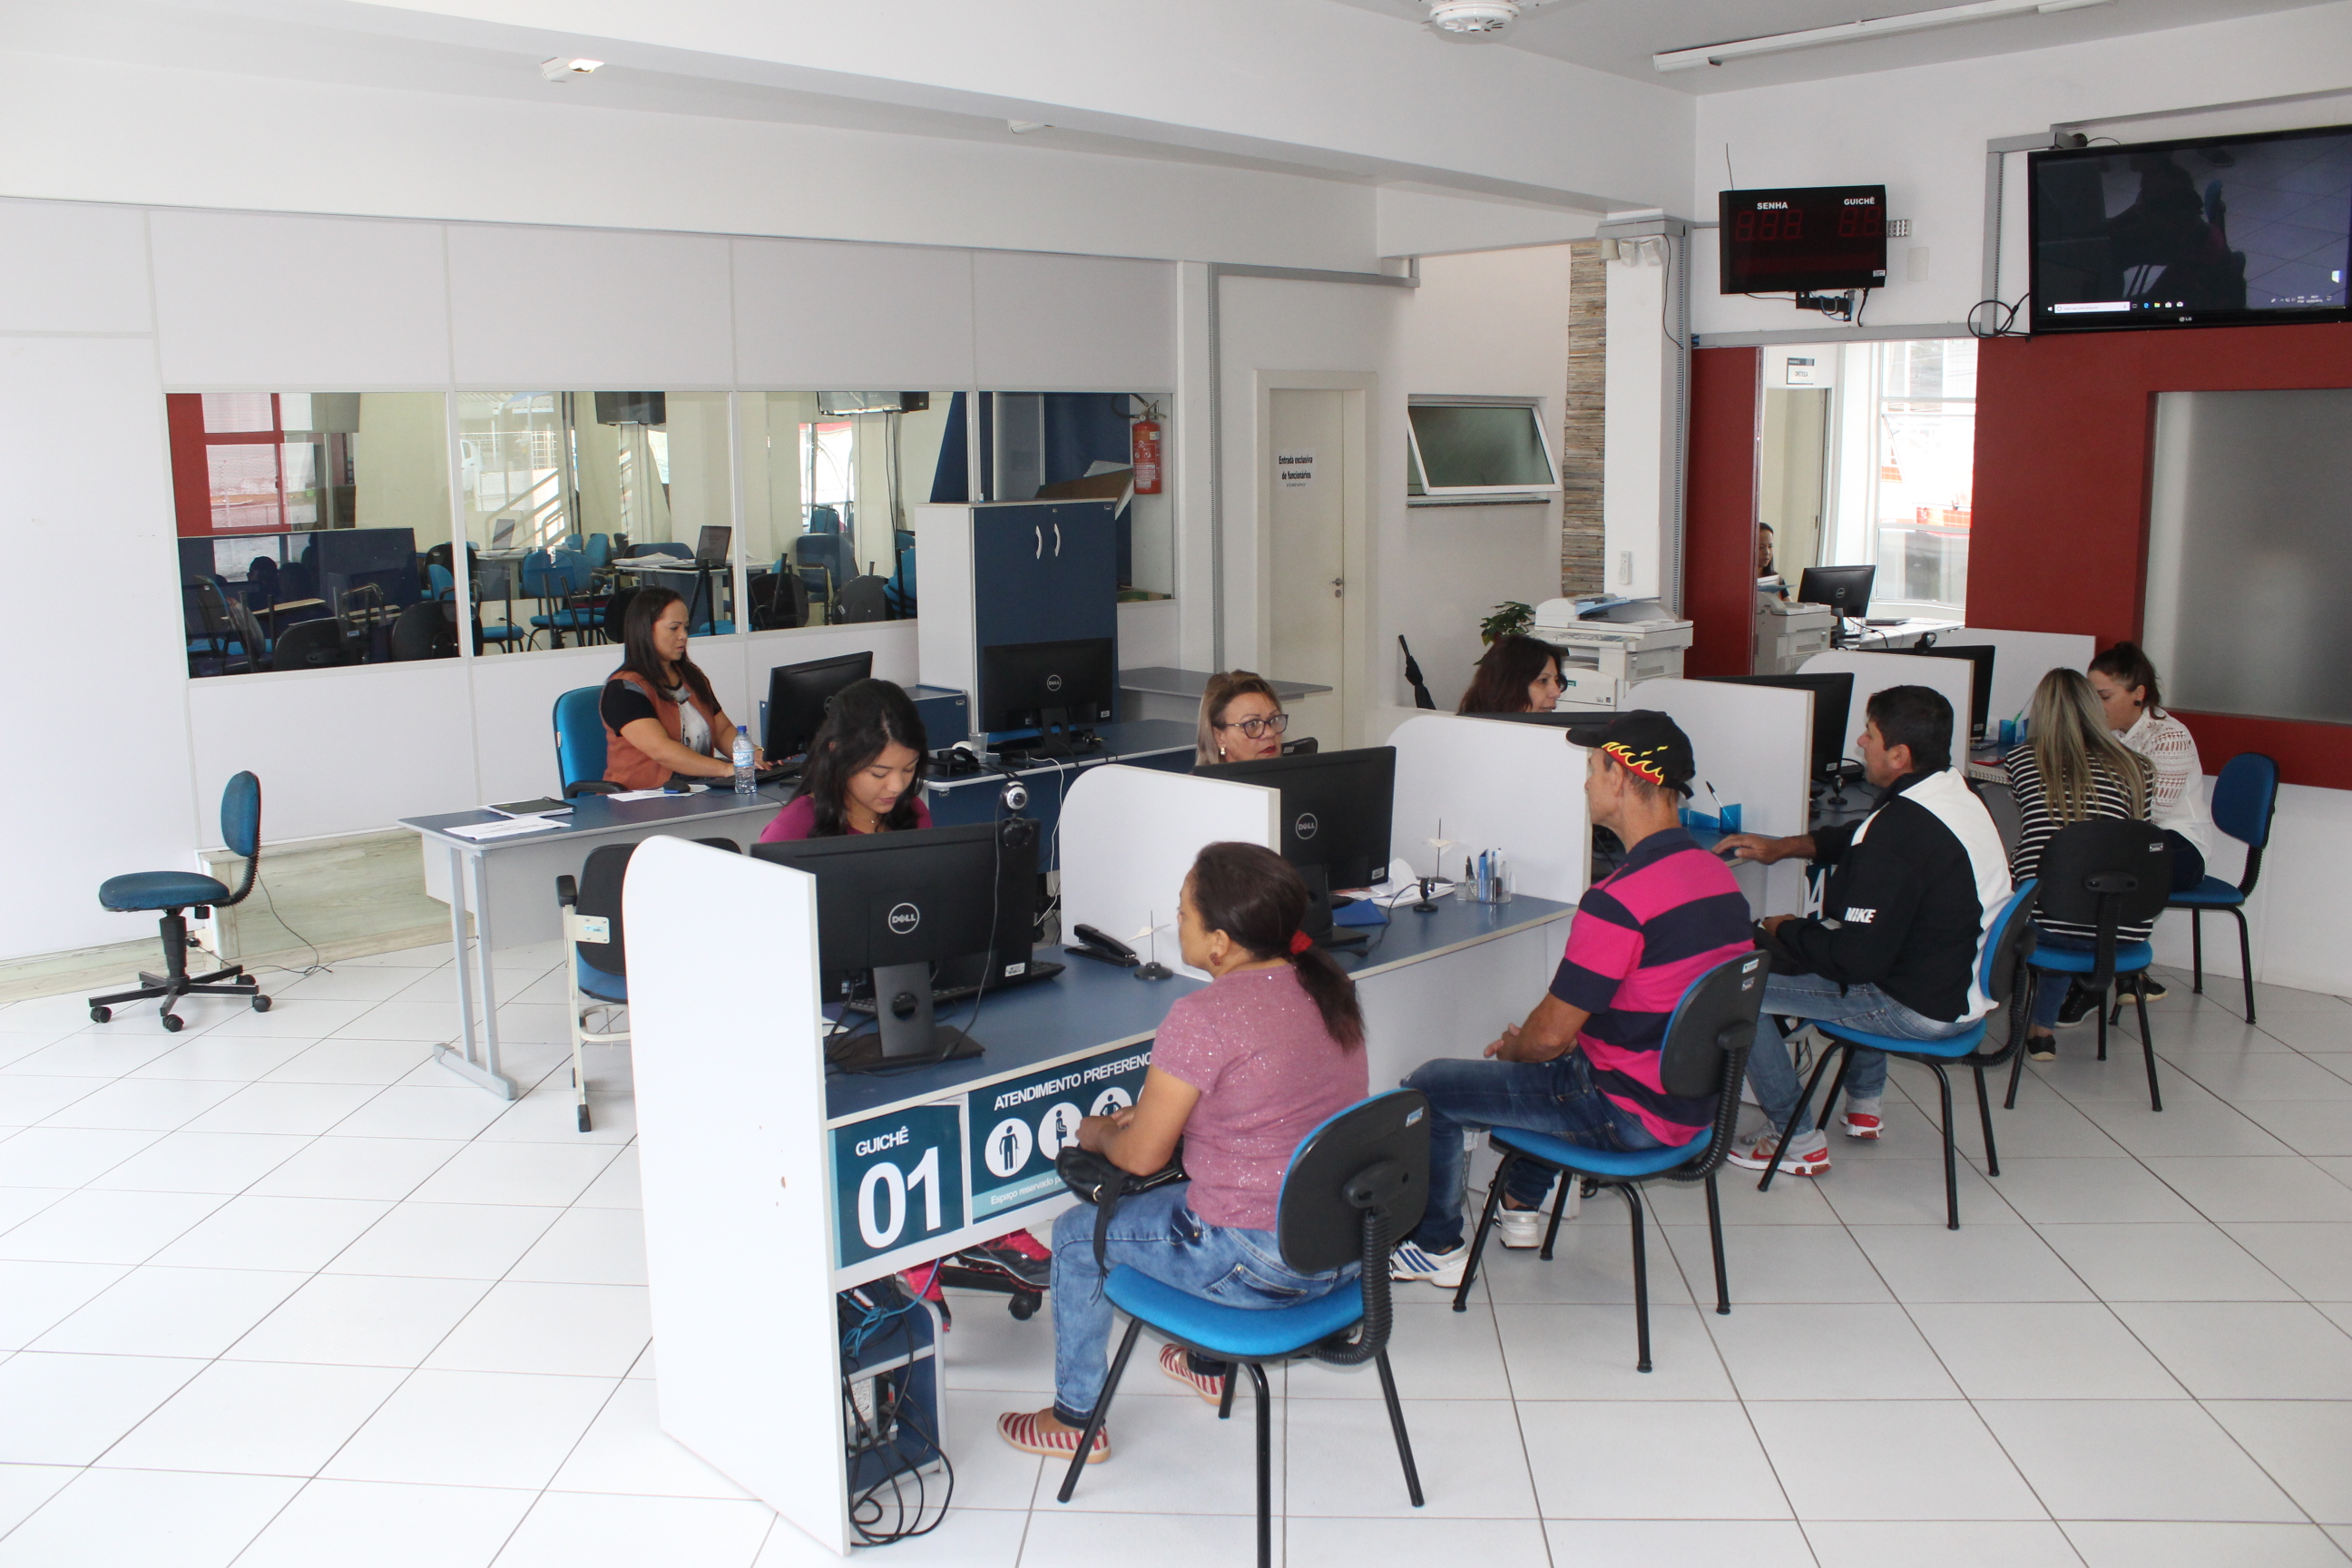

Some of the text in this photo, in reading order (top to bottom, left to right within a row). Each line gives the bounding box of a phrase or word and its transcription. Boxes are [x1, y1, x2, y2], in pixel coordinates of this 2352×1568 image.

[1757, 201, 1788, 210] SENHA
[1844, 196, 1876, 205] GUICHÊ
[1279, 456, 1313, 465] Entrada exclusiva
[1282, 471, 1311, 479] de funcionários
[892, 914, 916, 924] DELL
[1845, 907, 1877, 924] NIKE
[994, 1073, 1082, 1112] ATENDIMENTO
[856, 1125, 909, 1157] GUICHÊ
[858, 1146, 941, 1249] 01
[991, 1191, 1018, 1205] Espaço
[1019, 1178, 1054, 1195] reservado
